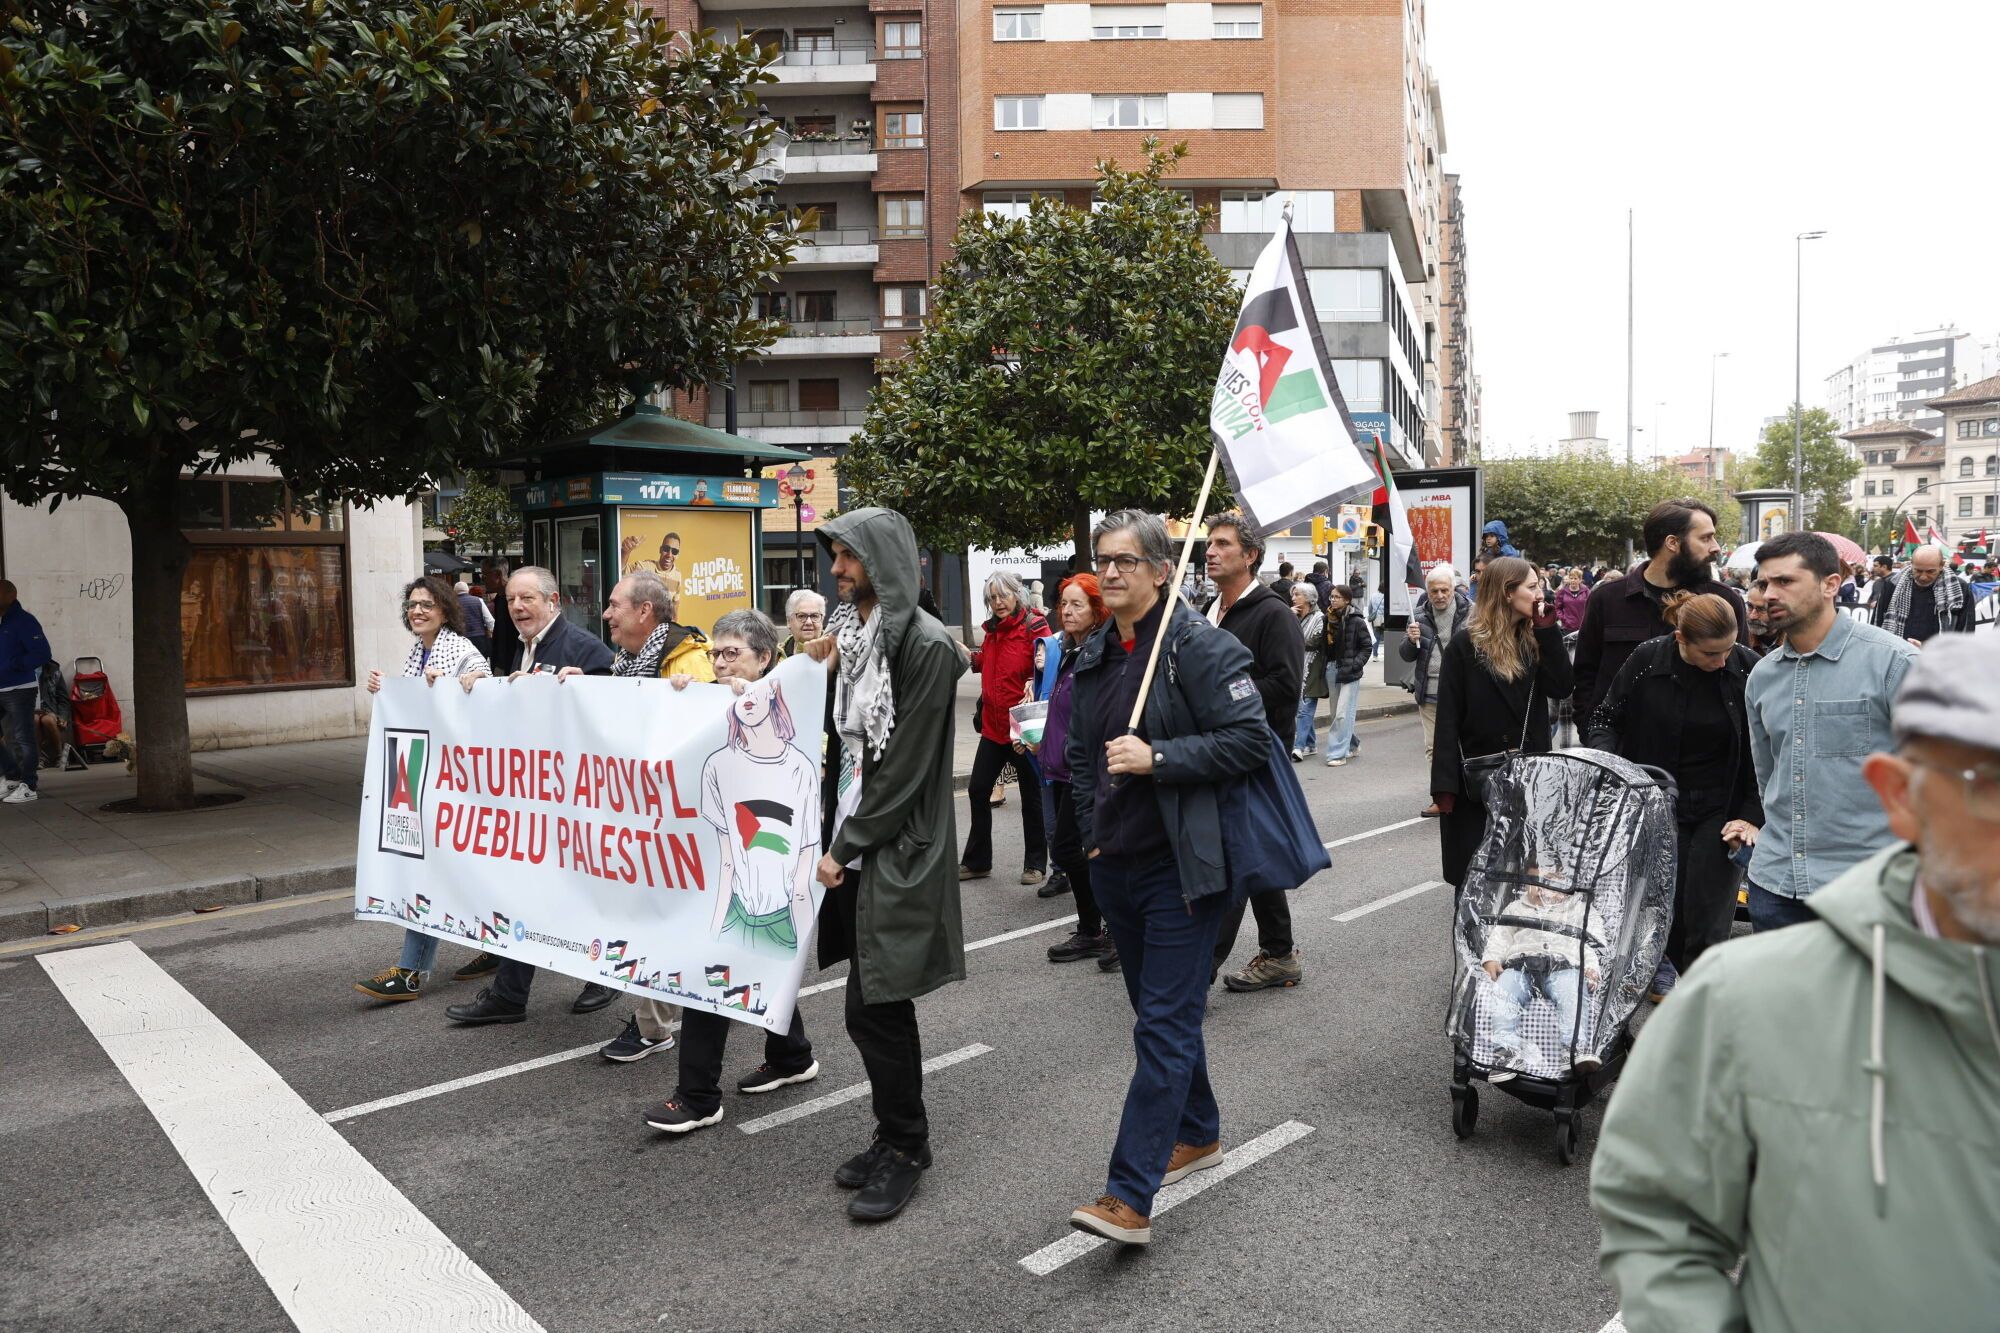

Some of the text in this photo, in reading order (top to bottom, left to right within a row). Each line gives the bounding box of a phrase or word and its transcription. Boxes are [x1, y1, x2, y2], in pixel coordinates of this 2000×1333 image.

[639, 485, 681, 500] 11/11
[692, 557, 735, 577] AHORA
[684, 572, 744, 597] SIEMPRE
[706, 591, 747, 601] BIEN JUGADO
[435, 744, 698, 819] ASTURIES APOYA'L
[387, 813, 409, 829] ASTURIES
[386, 826, 421, 848] PALESTINA
[435, 802, 705, 891] PUEBLU PALESTÍN
[525, 930, 590, 955] @ASTURIESCONPALESTINA
